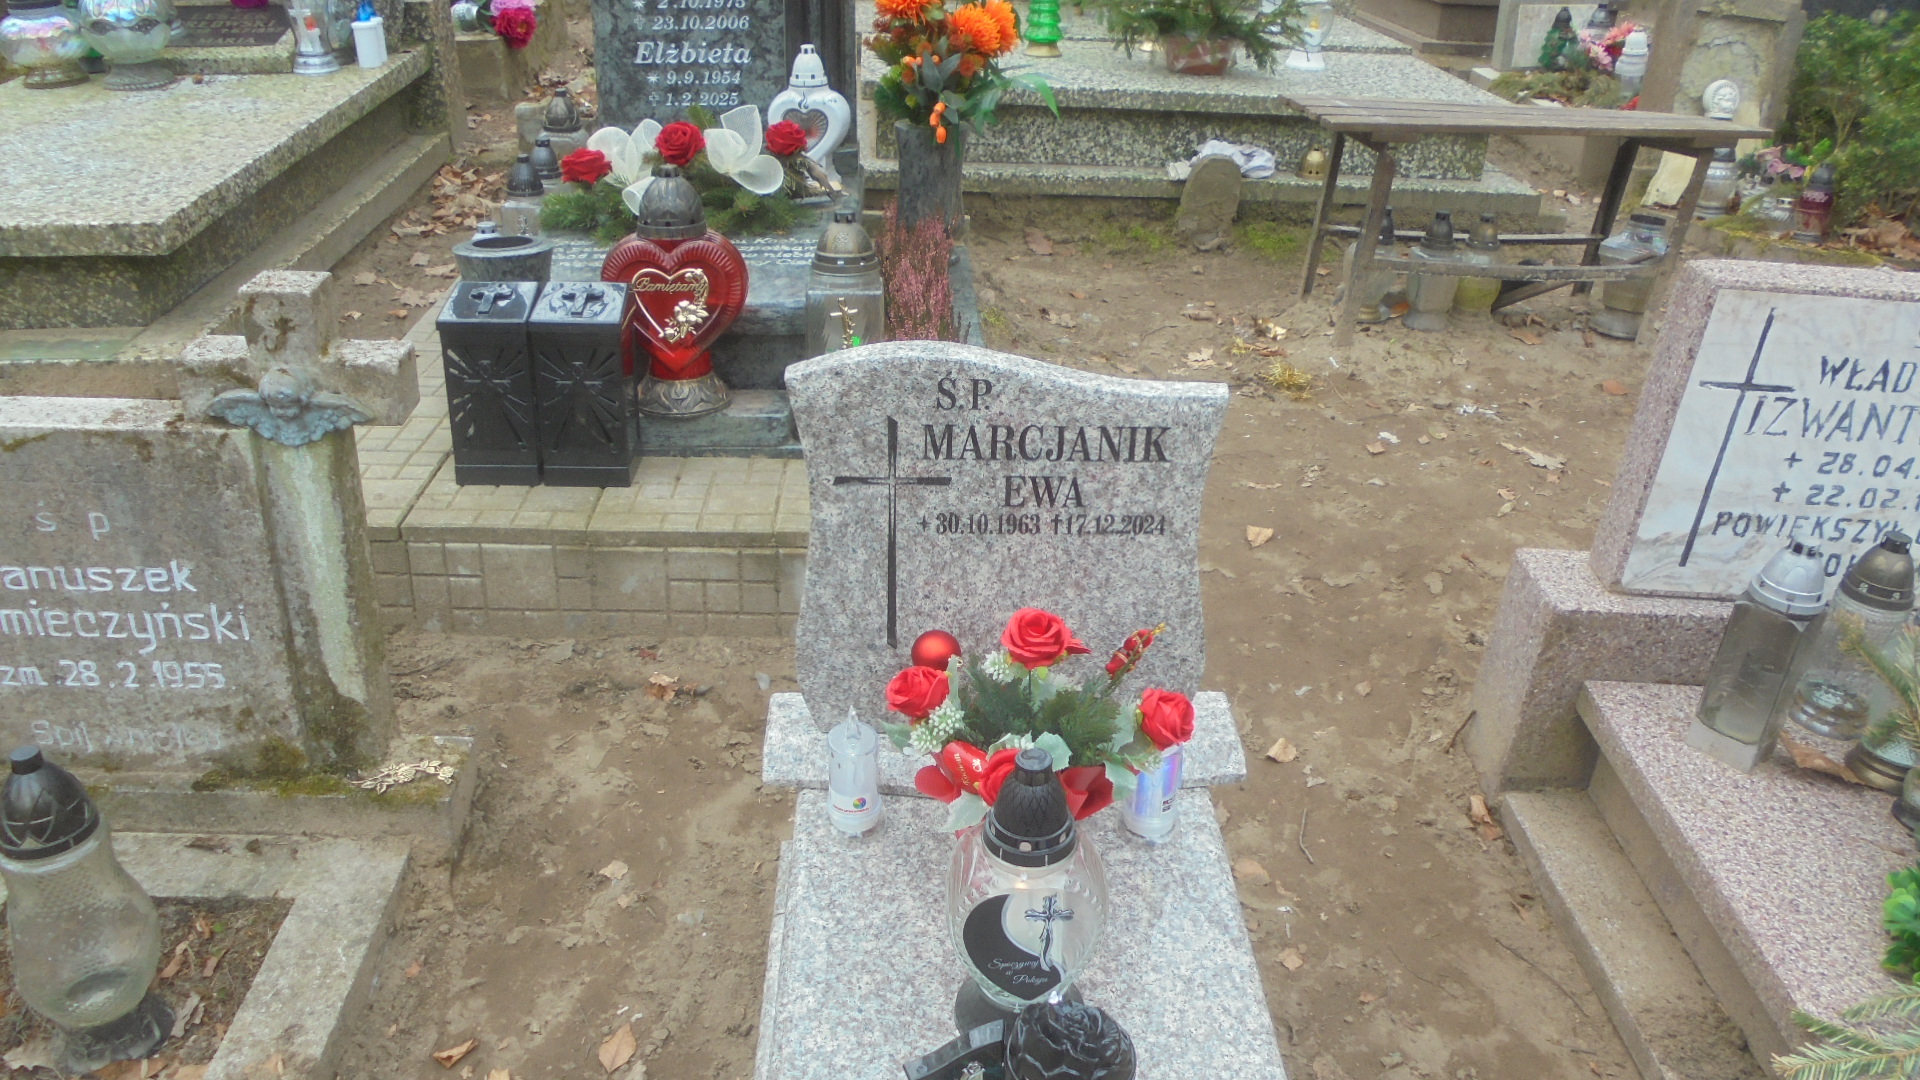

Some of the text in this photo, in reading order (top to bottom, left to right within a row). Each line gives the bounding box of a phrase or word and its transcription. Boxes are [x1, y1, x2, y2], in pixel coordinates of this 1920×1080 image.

[651, 15, 750, 30] 23.10.2006
[633, 41, 752, 64] Elżbieta
[665, 70, 742, 85] 9.9.1954
[664, 92, 739, 106] 1.2.2025
[634, 277, 708, 298] Pamiętamy
[1744, 395, 1920, 445] IZWANT
[921, 424, 1171, 463] MARCJANIK
[1003, 475, 1085, 507] EWA
[936, 513, 1166, 536] 30.10.1963 17.12.2024
